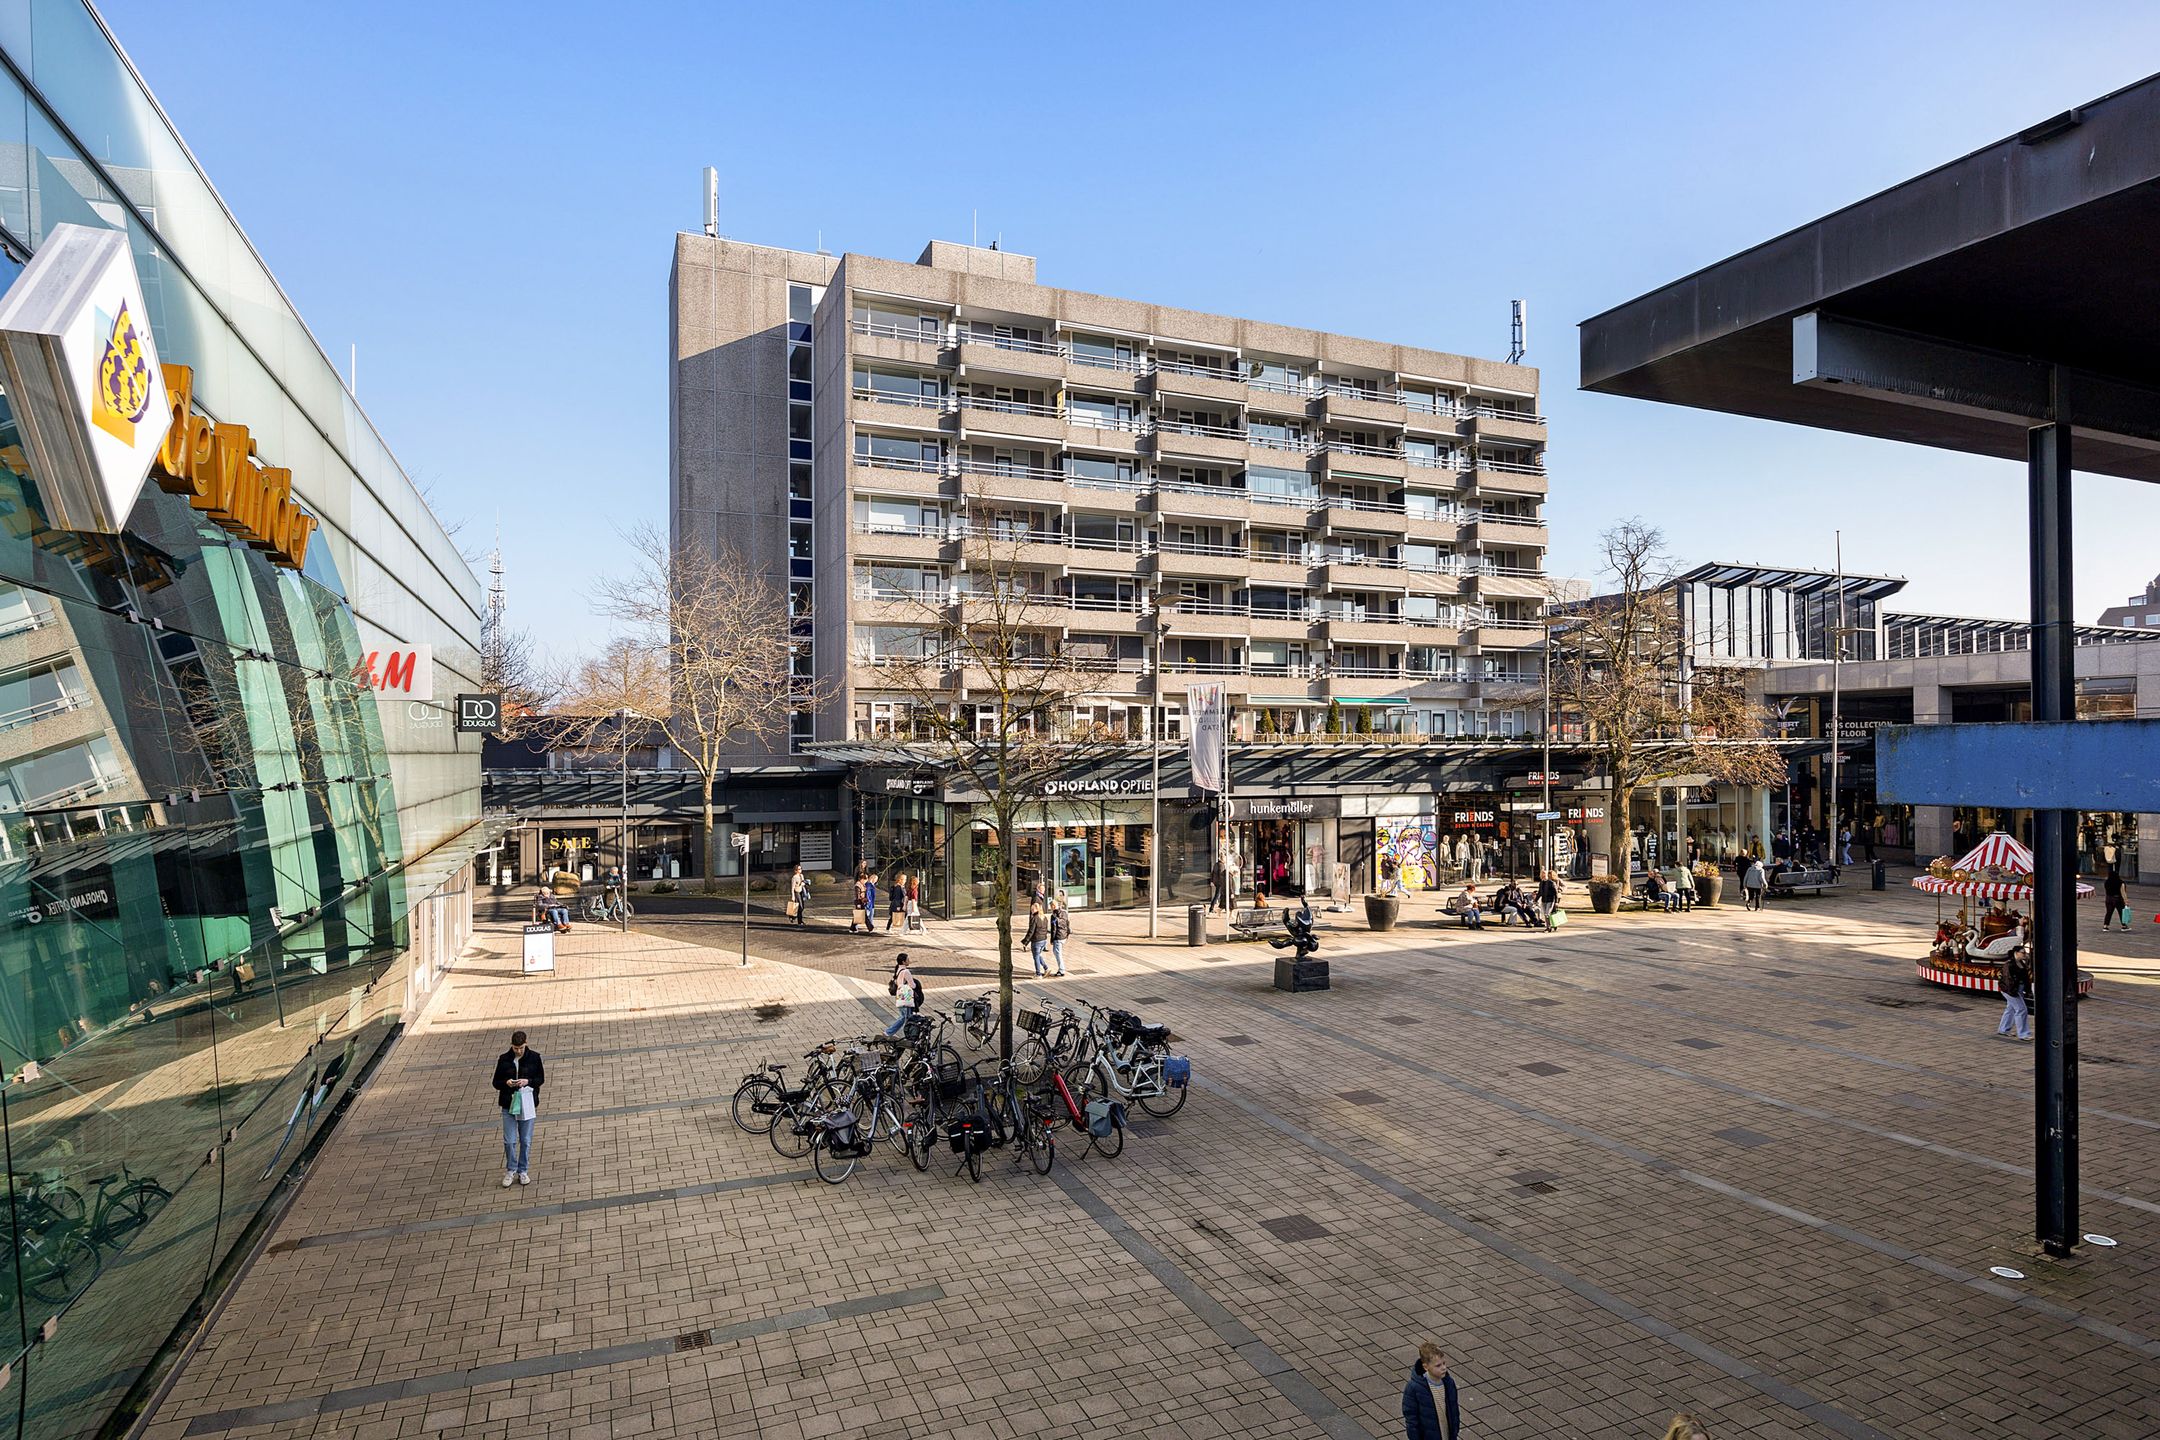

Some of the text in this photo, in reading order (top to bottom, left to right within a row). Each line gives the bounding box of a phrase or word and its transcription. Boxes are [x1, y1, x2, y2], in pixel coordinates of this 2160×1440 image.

[1845, 720, 1893, 729] COLLECTION
[1527, 771, 1560, 781] FRIEDS
[1058, 779, 1154, 791] HOFLAND OPTIE
[1250, 800, 1314, 814] hunkemöller
[1454, 811, 1494, 823] FRIENDS
[549, 837, 592, 850] SALE
